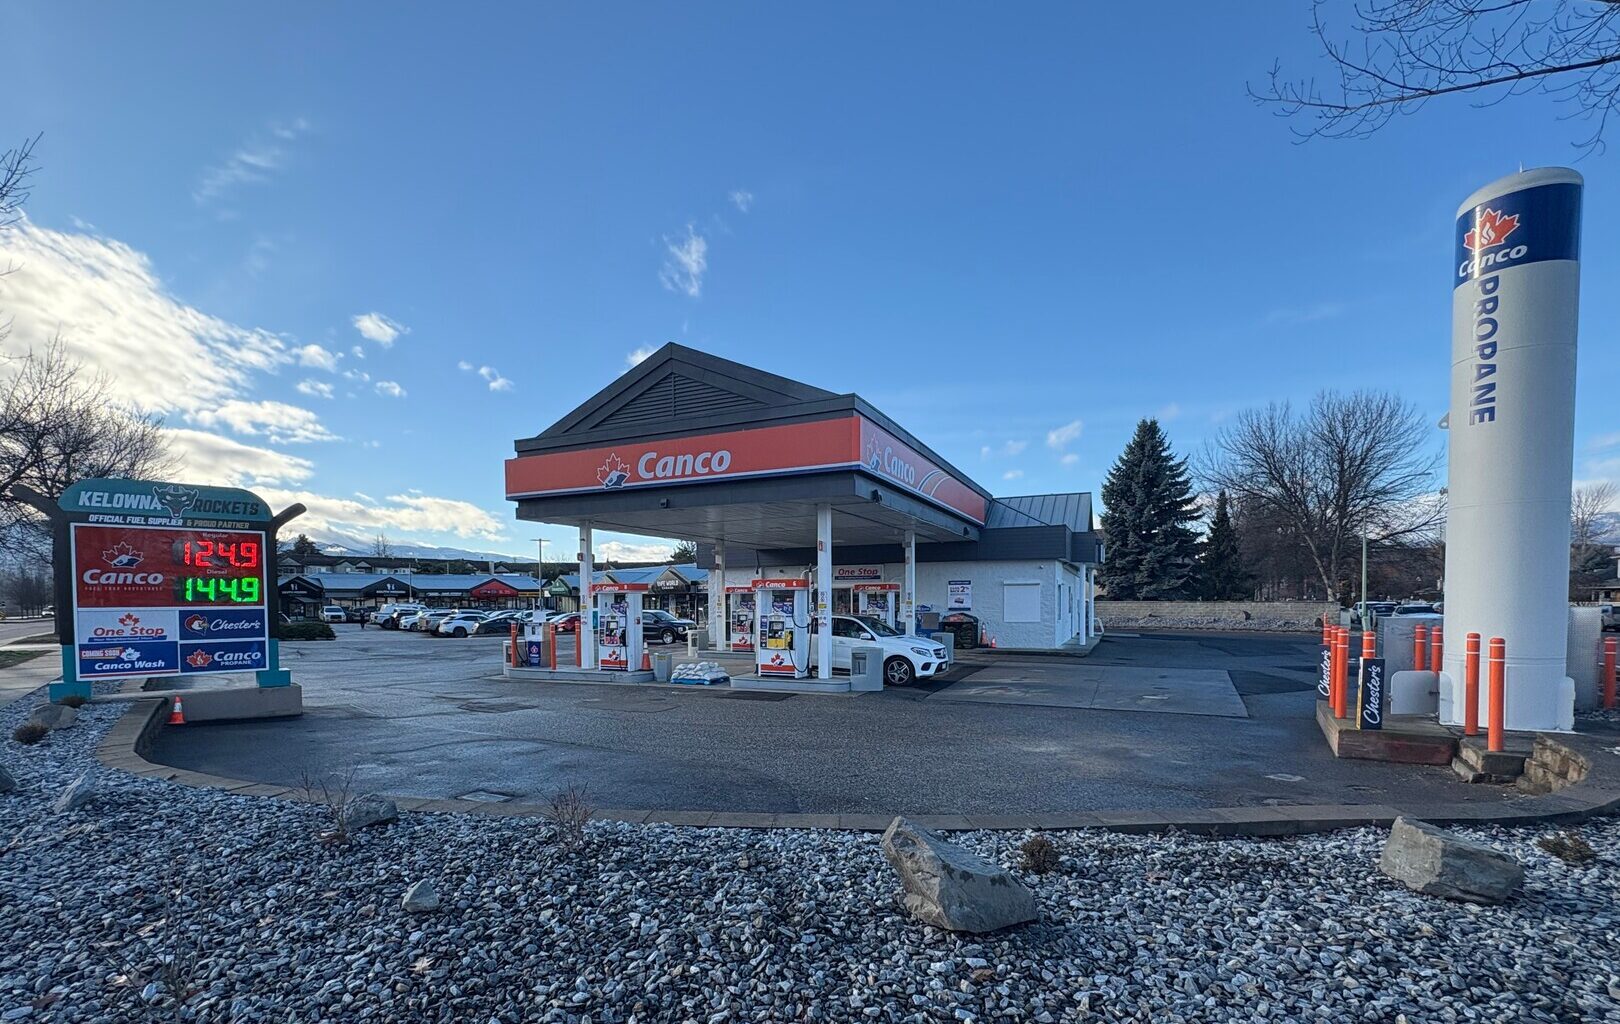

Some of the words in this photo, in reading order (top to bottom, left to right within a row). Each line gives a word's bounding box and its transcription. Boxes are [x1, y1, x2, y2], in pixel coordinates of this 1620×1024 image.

[1459, 244, 1528, 278] Canco
[1469, 274, 1500, 426] PROPANE
[637, 450, 732, 479] Canco
[884, 446, 915, 484] Canco
[78, 491, 161, 510] KELOWNA
[193, 500, 259, 516] ROCKETS
[88, 514, 125, 524] OFFICIAL
[126, 516, 146, 525] FUEL
[147, 518, 183, 526] SUPPLIER
[193, 520, 217, 528] PROUD
[217, 521, 249, 529] PARTNER
[83, 568, 164, 585] Canco
[837, 568, 856, 576] One
[857, 567, 878, 576] Stop
[93, 627, 125, 637] One
[129, 626, 165, 637] Stop
[210, 618, 261, 631] Chester's
[81, 650, 104, 658] COMING
[104, 649, 120, 657] SOON
[213, 651, 262, 662] Canco
[94, 662, 132, 671] Canco
[134, 659, 165, 669] Wash
[1363, 665, 1381, 724] Chester's
